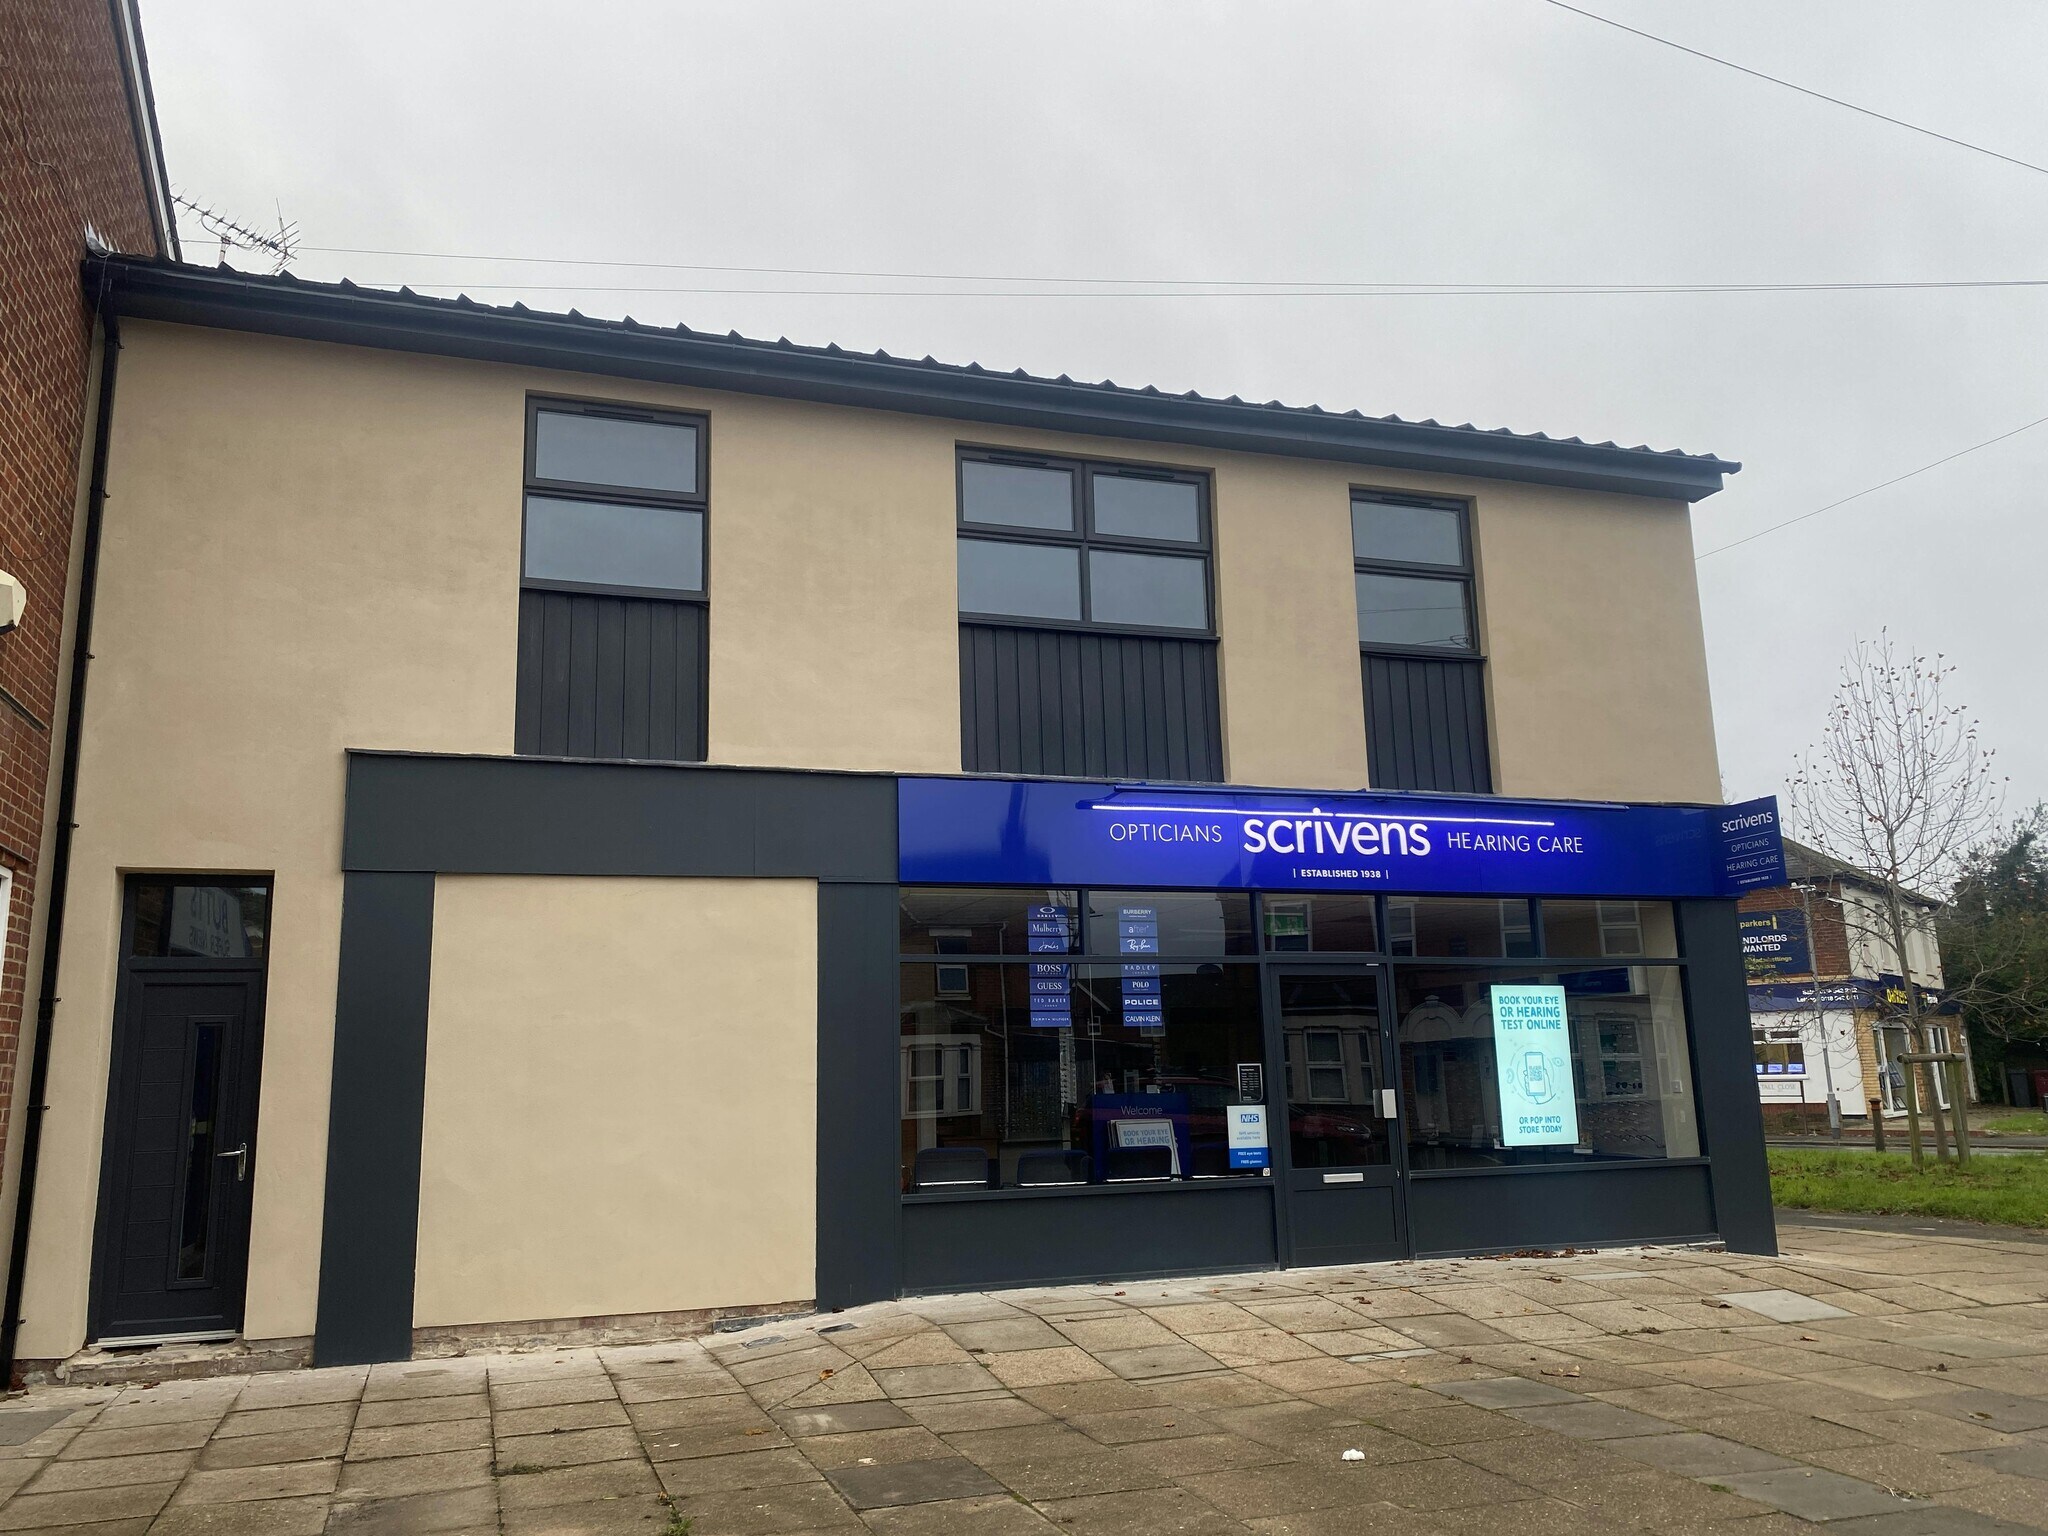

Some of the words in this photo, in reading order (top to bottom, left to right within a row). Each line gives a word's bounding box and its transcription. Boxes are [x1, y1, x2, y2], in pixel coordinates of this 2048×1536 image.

[1722, 812, 1773, 833] scrivens
[1109, 823, 1222, 842] OPTICIANS
[1243, 807, 1431, 856] scrivens
[1447, 832, 1531, 852] HEARING
[1537, 836, 1584, 853] CARE
[1731, 838, 1769, 853] OPTICIANS
[1727, 859, 1758, 871] HEARING
[1760, 855, 1779, 865] CARE
[1301, 869, 1358, 878] ESTABLISHED
[1360, 871, 1381, 879] 1938
[1032, 923, 1062, 934] Mulberry
[1740, 919, 1771, 930] parkers
[1037, 964, 1061, 973] BOSS
[1037, 982, 1062, 990] GUESS
[1499, 996, 1521, 1005] BOOK
[1522, 996, 1544, 1005] YOUR
[1545, 996, 1559, 1005] EYE
[1500, 1006, 1515, 1018] OR
[1516, 1006, 1561, 1018] HEARING
[1501, 1019, 1524, 1030] TEST
[1526, 1019, 1561, 1030] ONLINE
[1120, 1105, 1163, 1116] Welcome
[1241, 1114, 1259, 1123] NHS
[1519, 1116, 1529, 1125] OR
[1530, 1116, 1543, 1125] POP
[1544, 1115, 1561, 1124] INTO
[1157, 1128, 1169, 1136] EYE
[1519, 1125, 1540, 1134] STORE
[1541, 1125, 1562, 1133] TODAY
[1124, 1138, 1136, 1146] OR
[1136, 1136, 1170, 1145] HEARING
